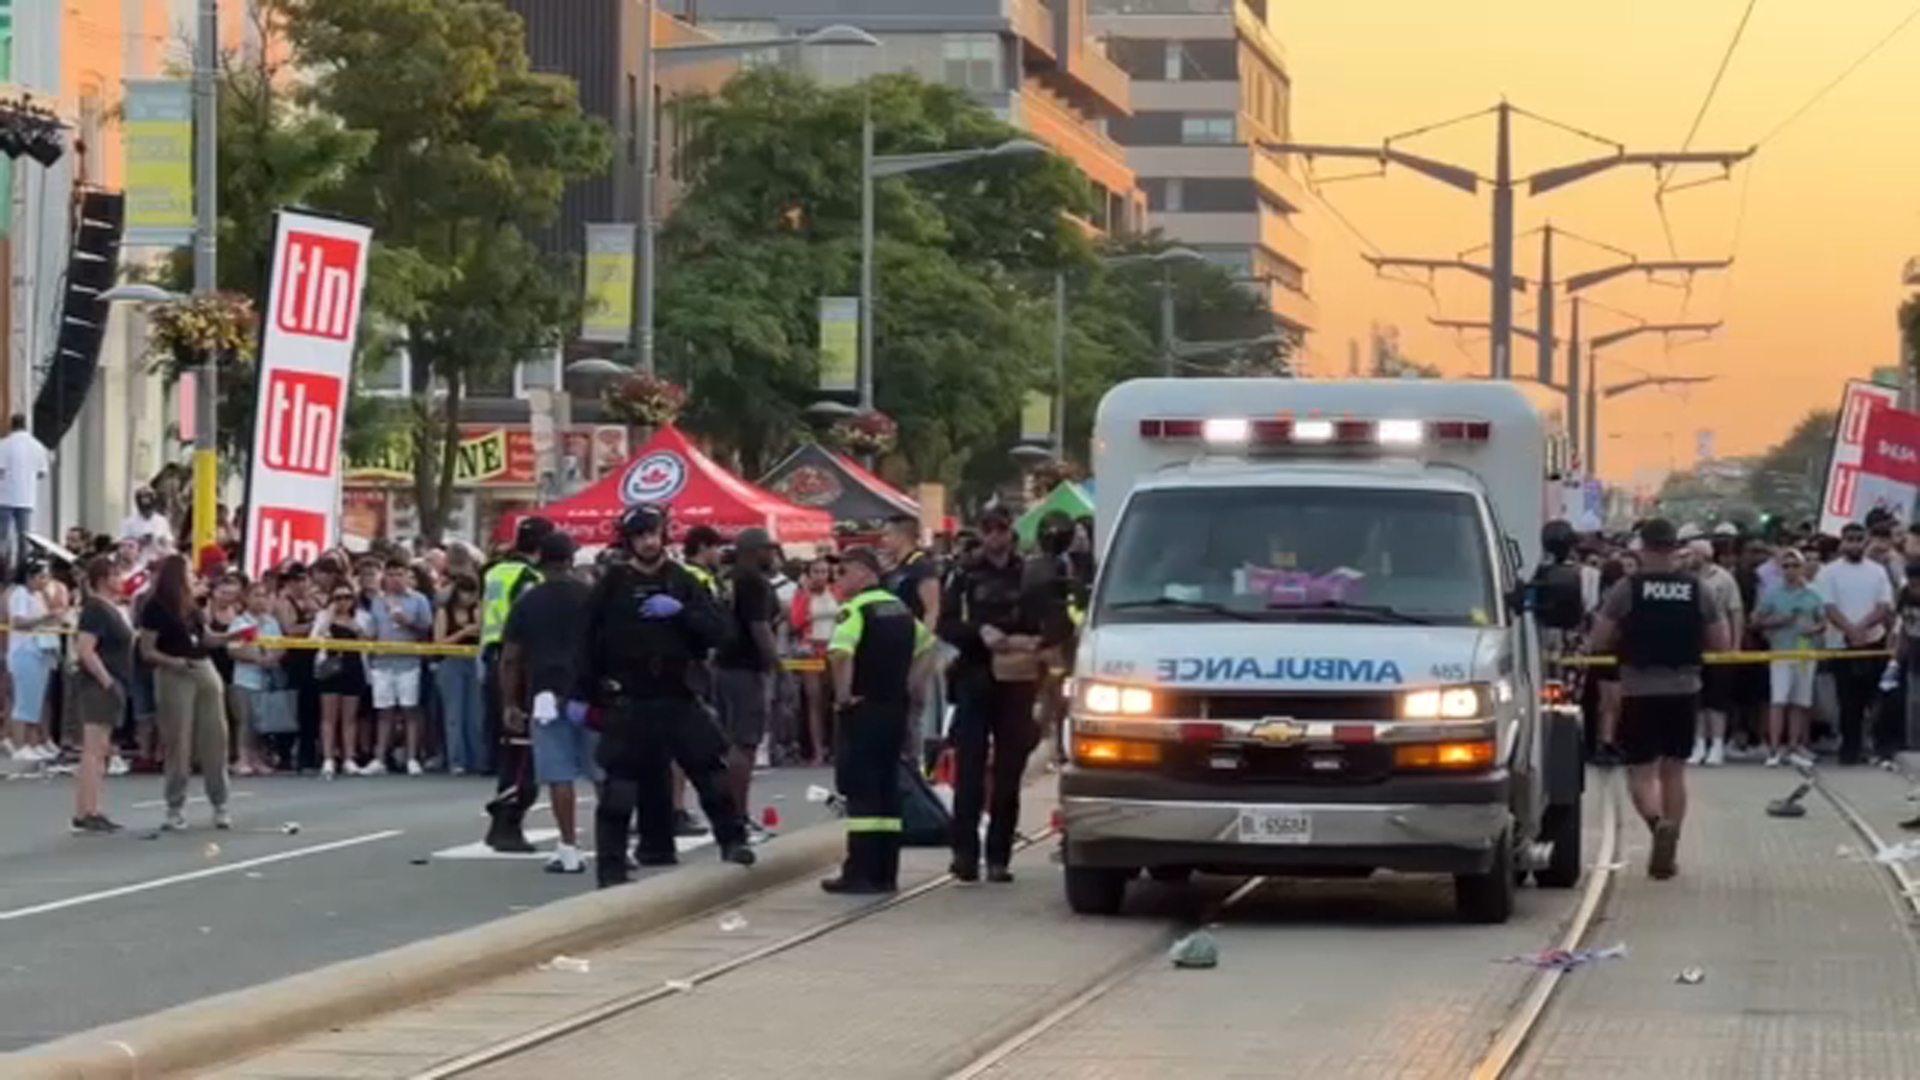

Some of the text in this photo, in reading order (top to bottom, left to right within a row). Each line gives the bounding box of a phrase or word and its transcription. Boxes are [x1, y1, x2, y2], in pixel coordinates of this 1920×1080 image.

[281, 241, 350, 339] tln
[268, 379, 334, 473] tln
[1643, 581, 1692, 601] POLICE
